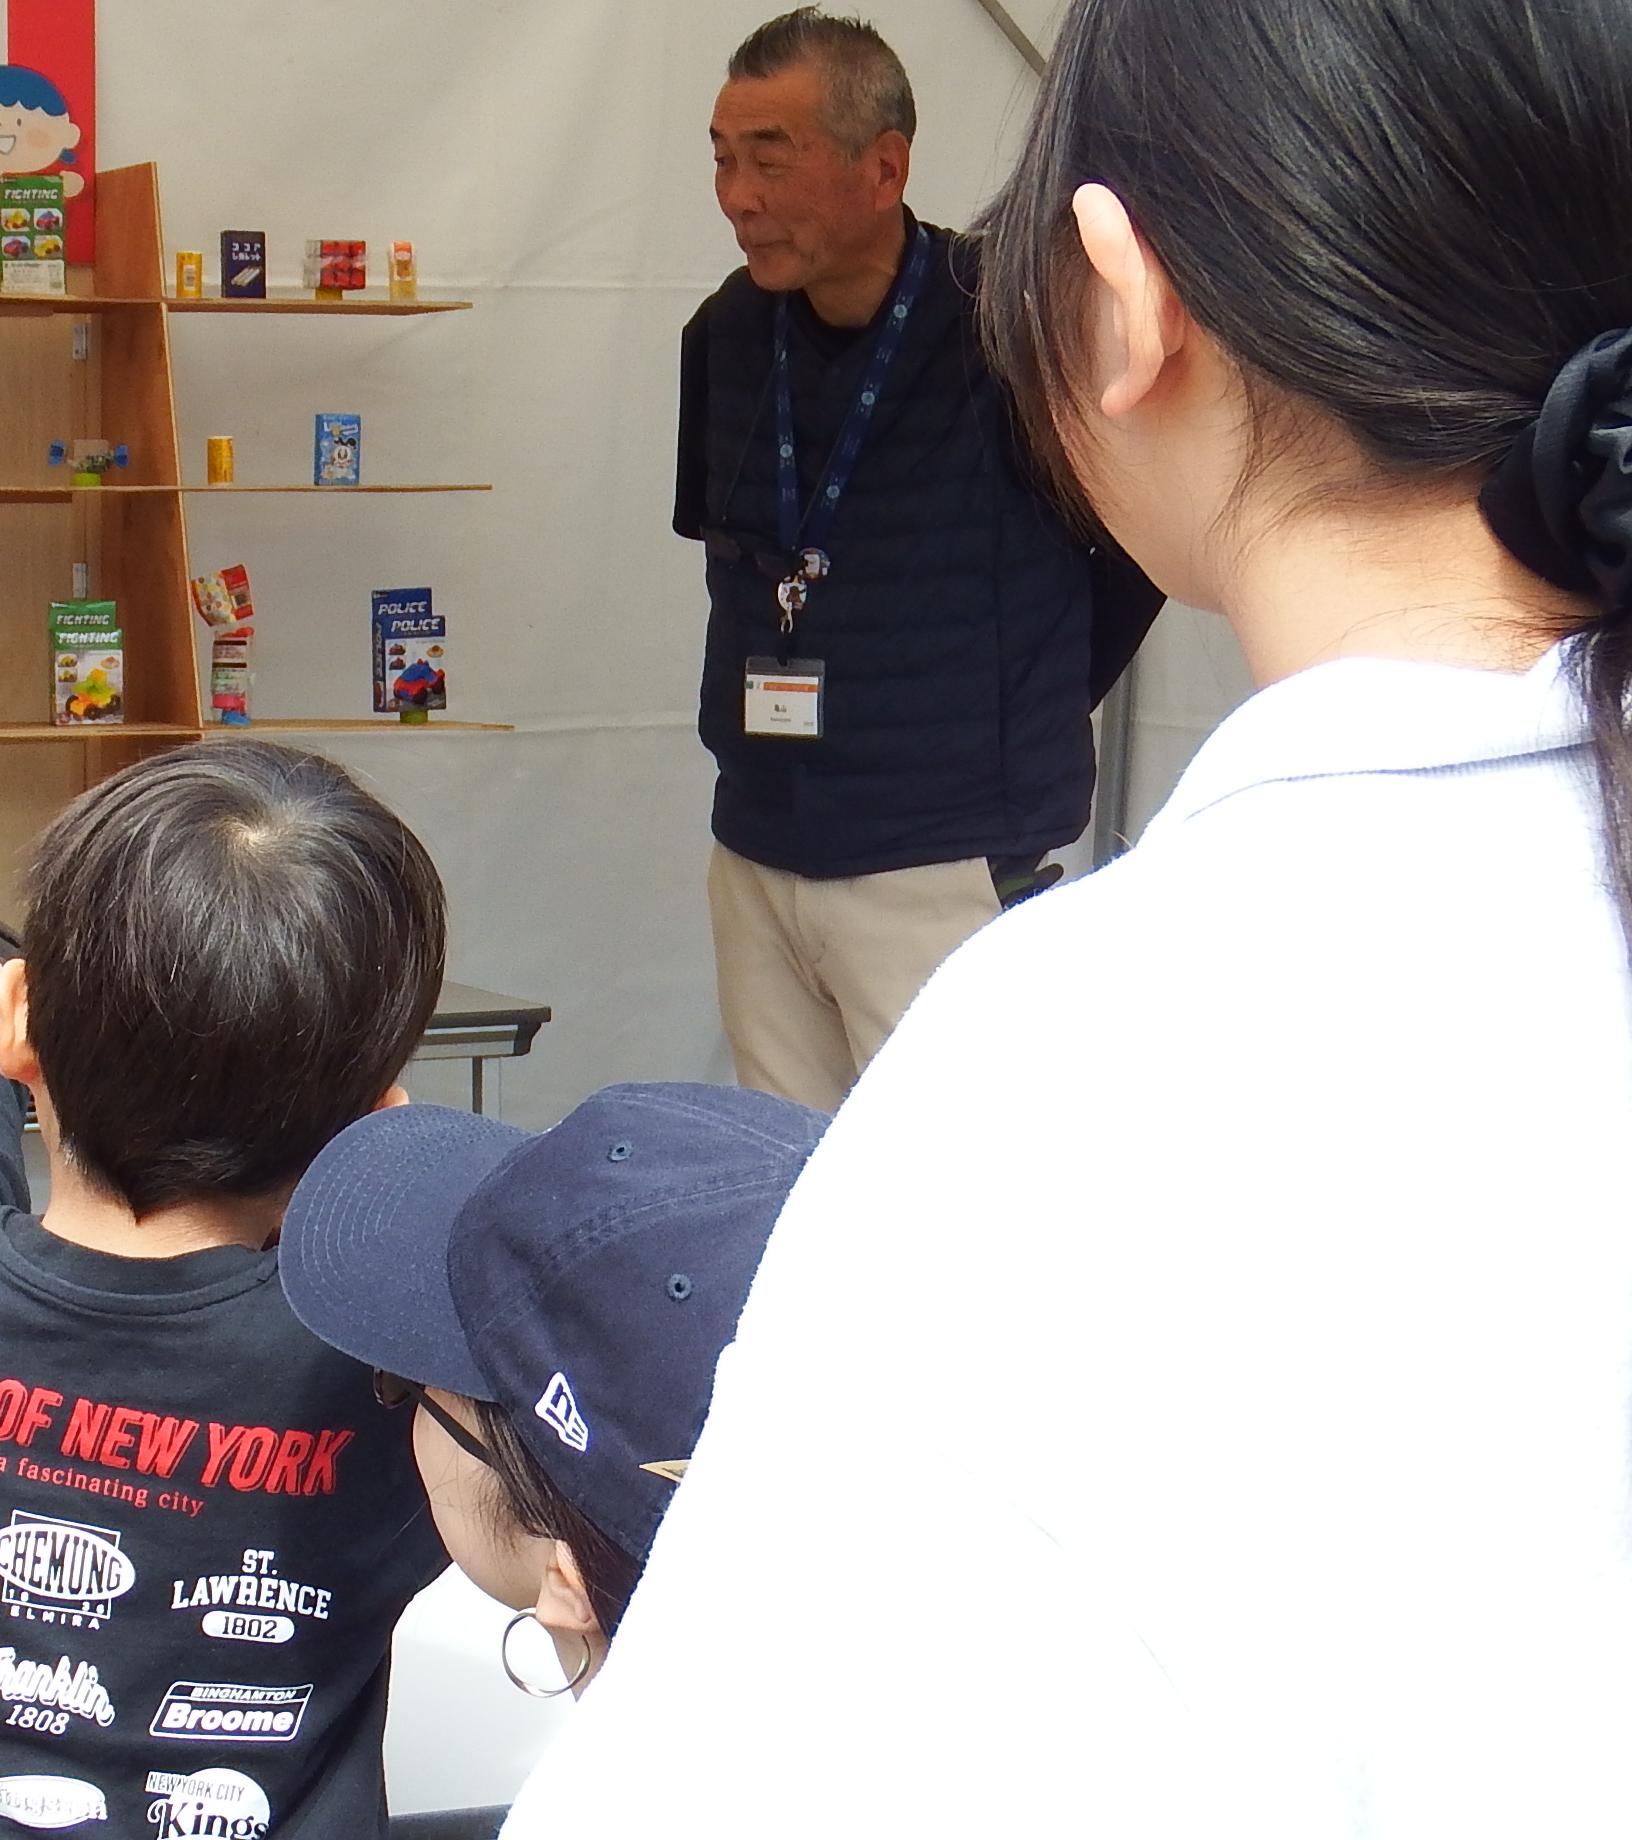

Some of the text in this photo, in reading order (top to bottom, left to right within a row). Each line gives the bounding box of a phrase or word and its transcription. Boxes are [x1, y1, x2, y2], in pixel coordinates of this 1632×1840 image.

[4, 188, 59, 200] FIGHTING
[56, 614, 110, 625] FIGHTING
[378, 601, 428, 615] POLICE
[58, 631, 119, 644] FIGHTING
[390, 618, 441, 632] POLICE
[60, 1398, 200, 1479] NEW
[200, 1421, 356, 1497] YORK
[16, 1457, 149, 1509] fascinating
[157, 1491, 204, 1518] city
[241, 1548, 278, 1575] ST.
[170, 1575, 333, 1620] LAWRENCE
[10, 1605, 101, 1631] ELMIRA
[222, 1615, 278, 1639] 1802
[190, 1686, 297, 1701] BINGHAMTON
[5, 1704, 70, 1735] 1808
[161, 1702, 295, 1732] Broome
[148, 1773, 245, 1802] NEW YORK CITY
[158, 1801, 269, 1840] Kings
